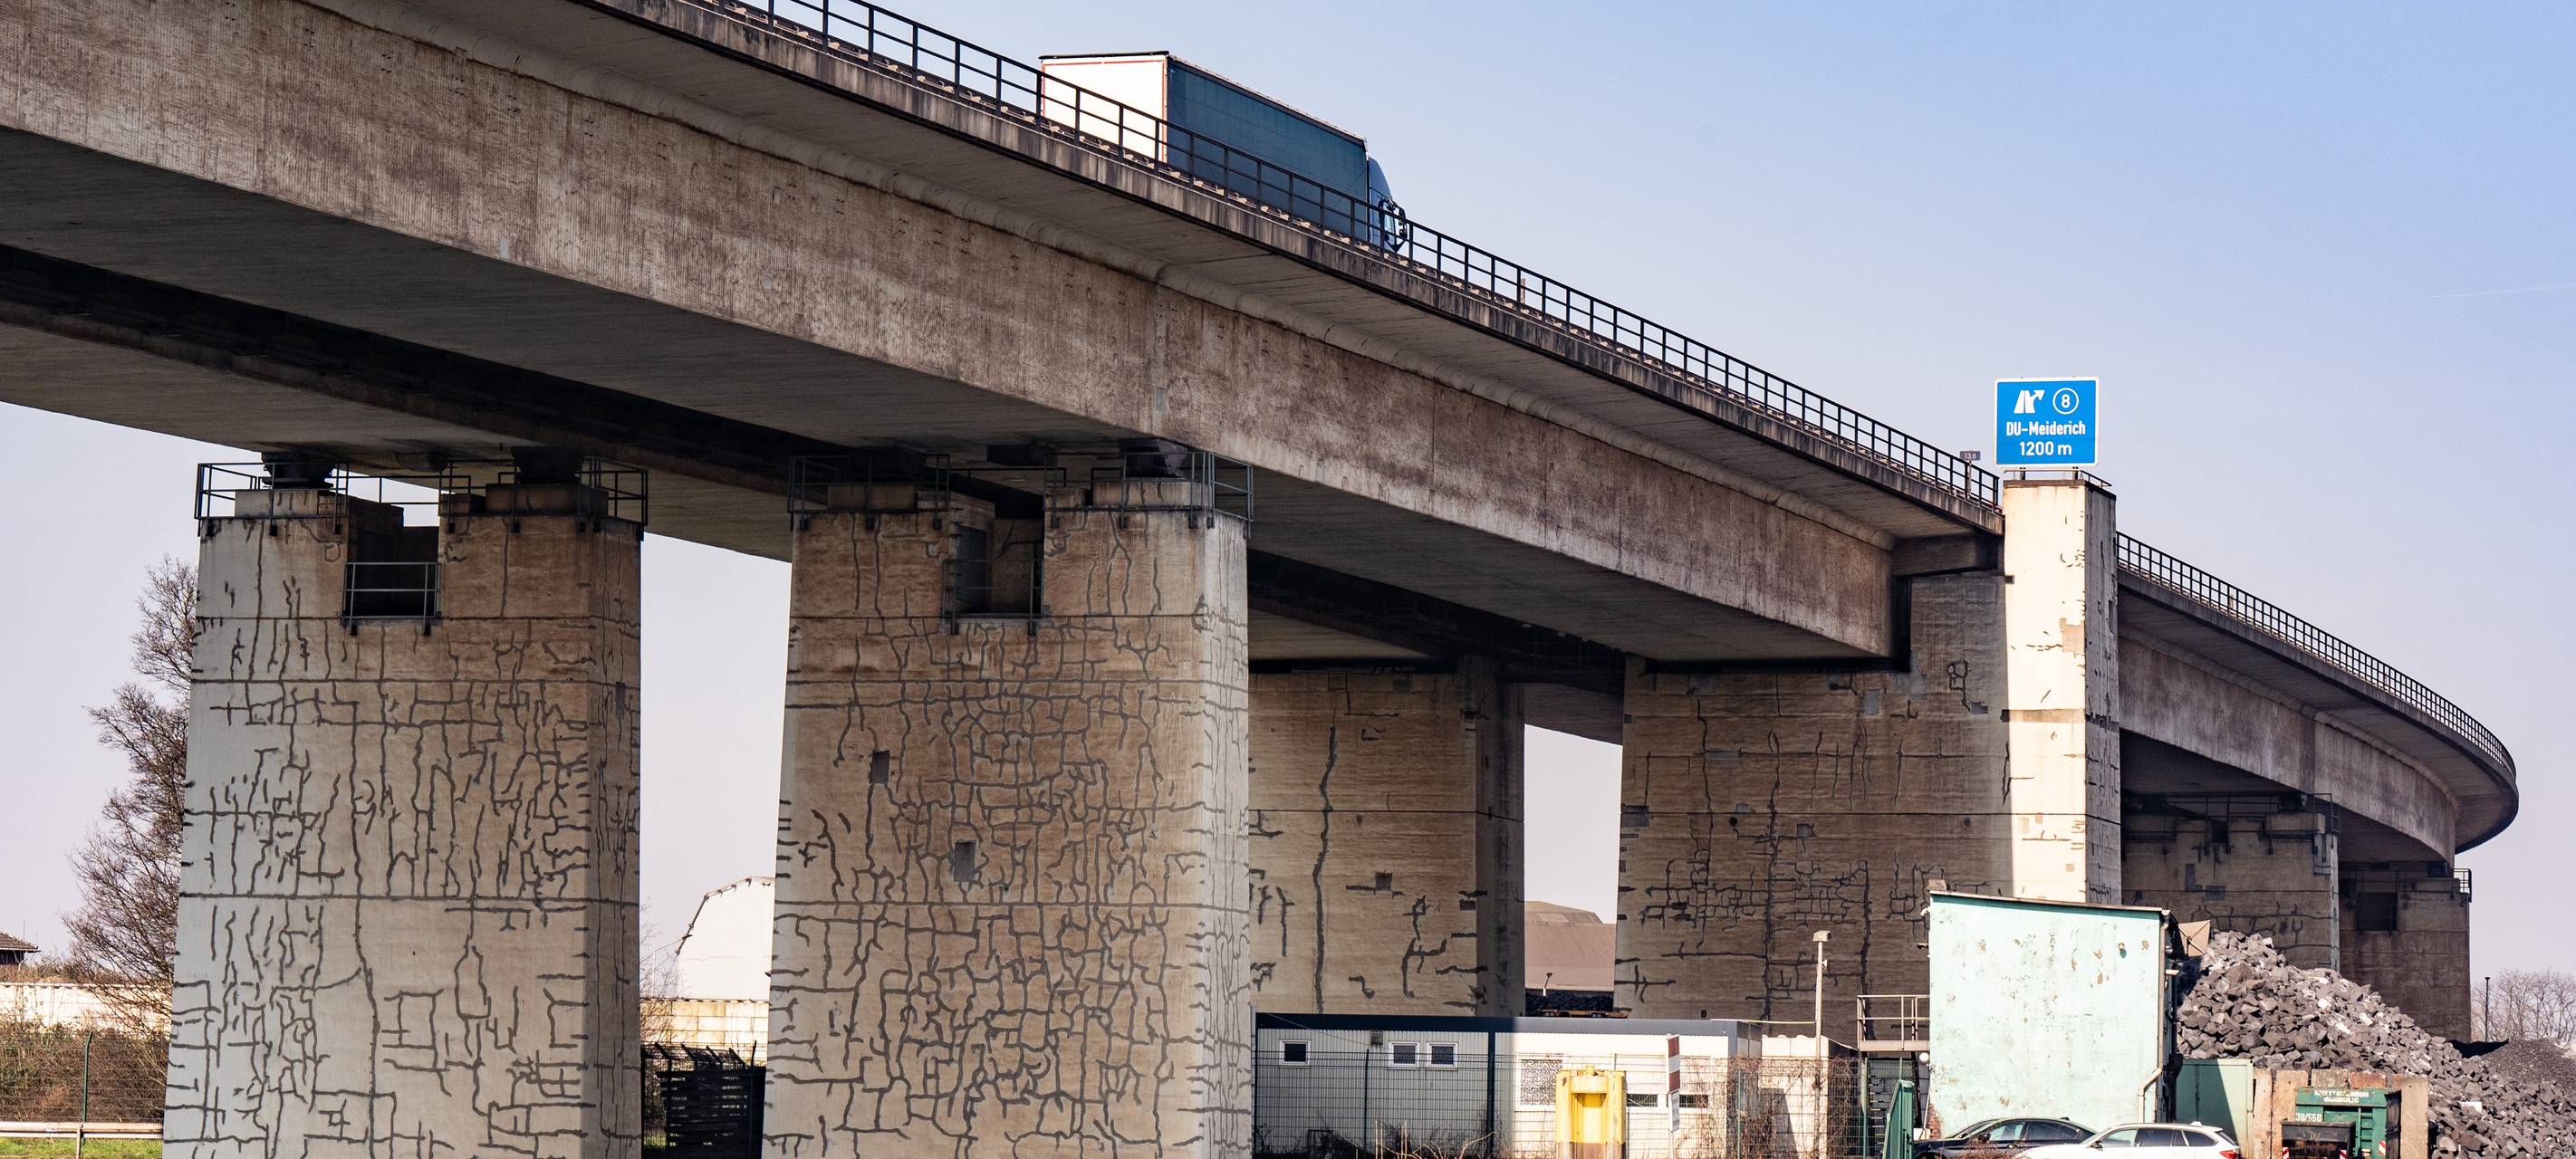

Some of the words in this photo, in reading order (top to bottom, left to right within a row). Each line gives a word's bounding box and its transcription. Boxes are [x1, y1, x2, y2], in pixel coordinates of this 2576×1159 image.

[2062, 393, 2071, 408] 8
[2005, 420, 2086, 436] DU-Meiderich
[2019, 441, 2054, 455] 1200
[2057, 444, 2072, 455] m
